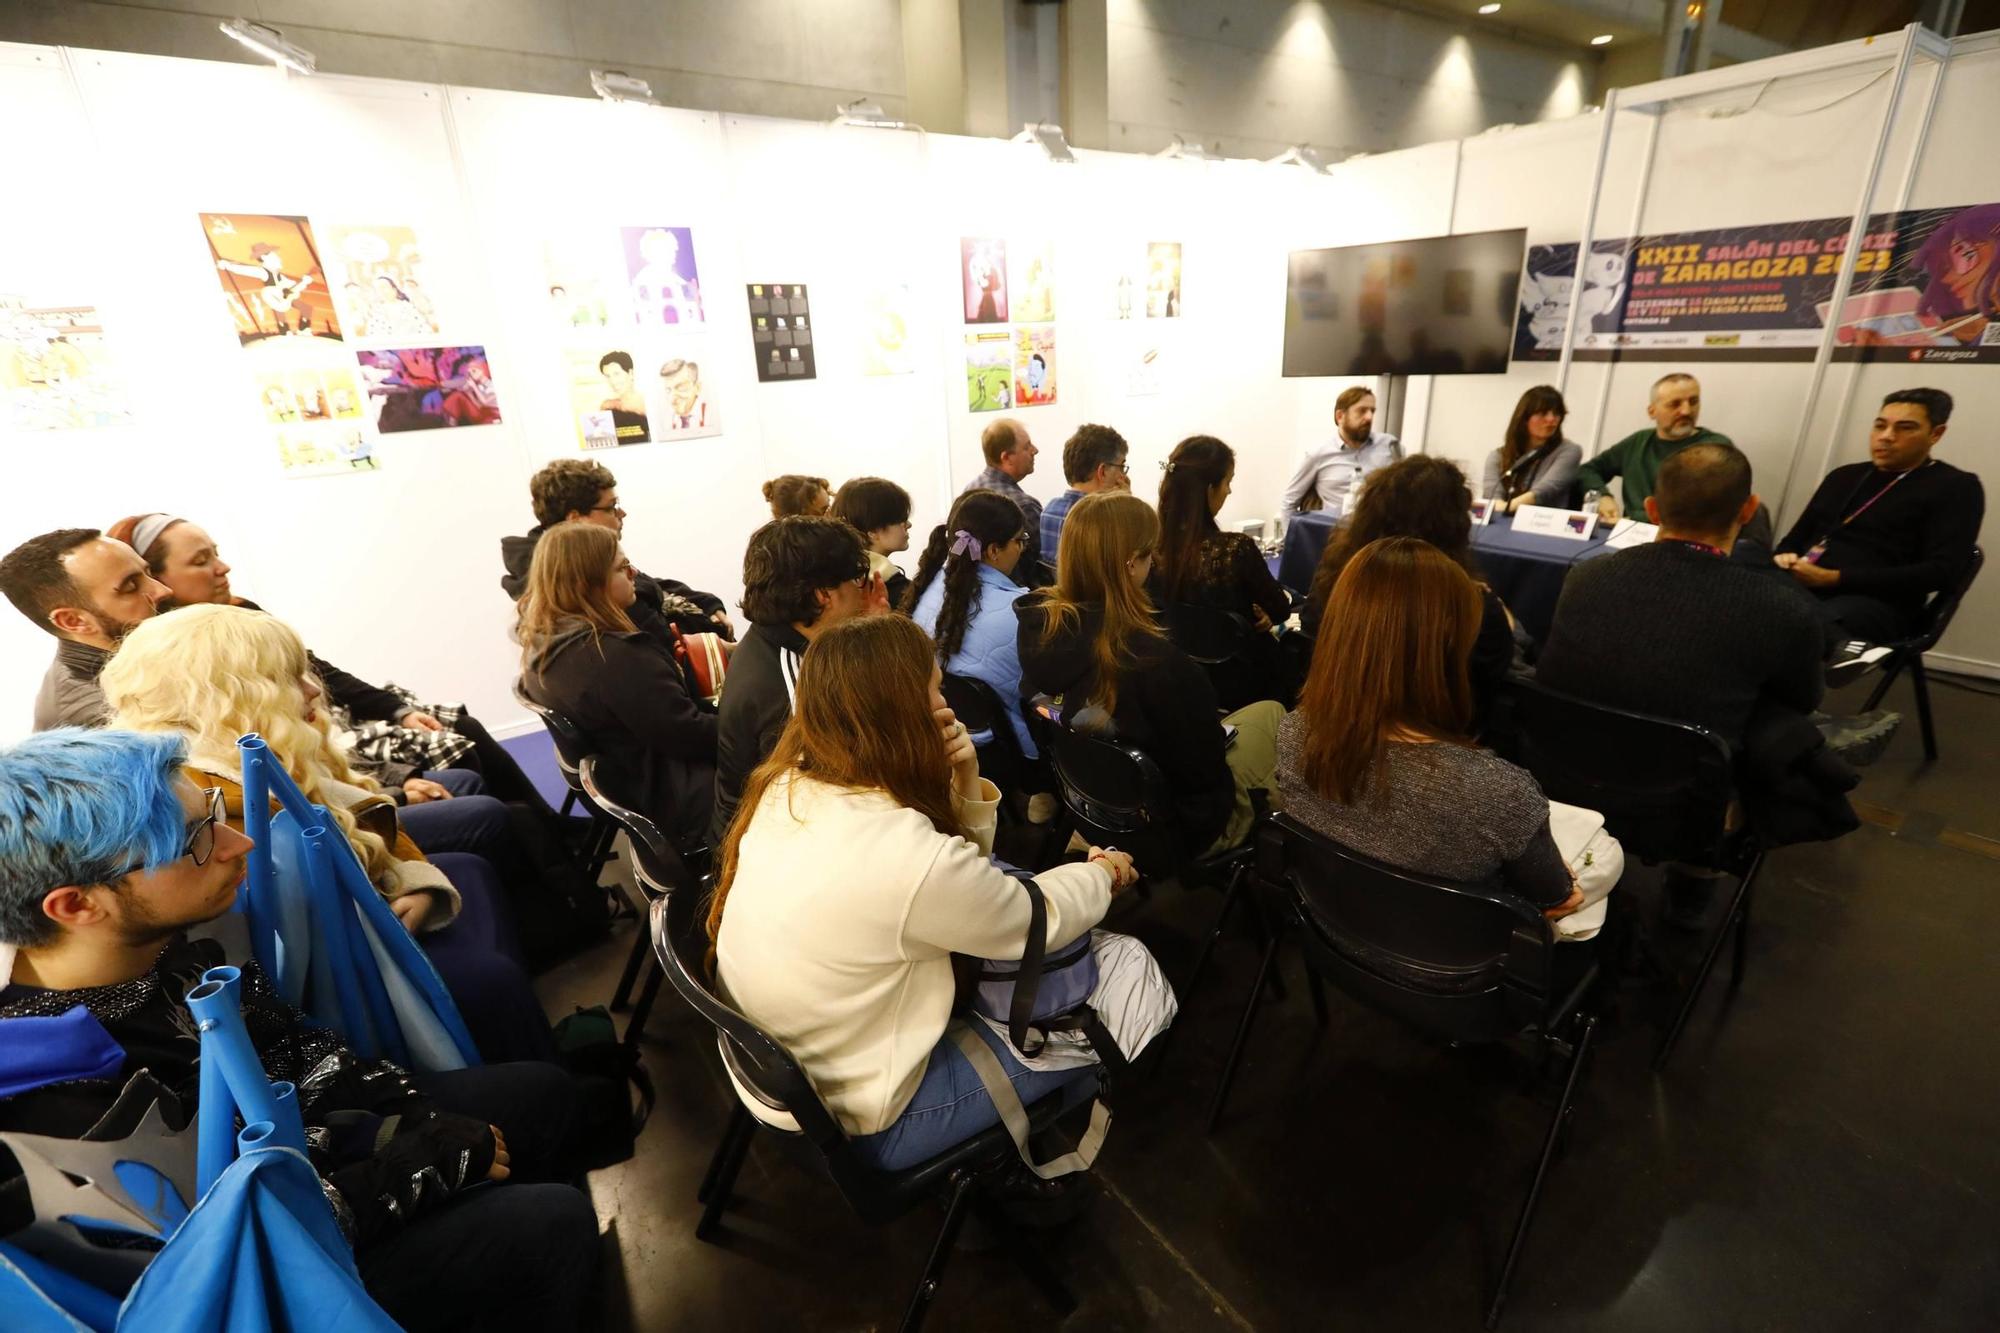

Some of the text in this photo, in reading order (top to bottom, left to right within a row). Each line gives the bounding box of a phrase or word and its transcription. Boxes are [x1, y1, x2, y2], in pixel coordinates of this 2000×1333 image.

[1637, 244, 1702, 267] XXII
[1705, 240, 1774, 262] SALÓN
[1776, 238, 1821, 256] DEL
[1632, 270, 1658, 286] DE
[1660, 256, 1808, 284] ZARAGOZA
[1923, 348, 1979, 361] Zaragoza
